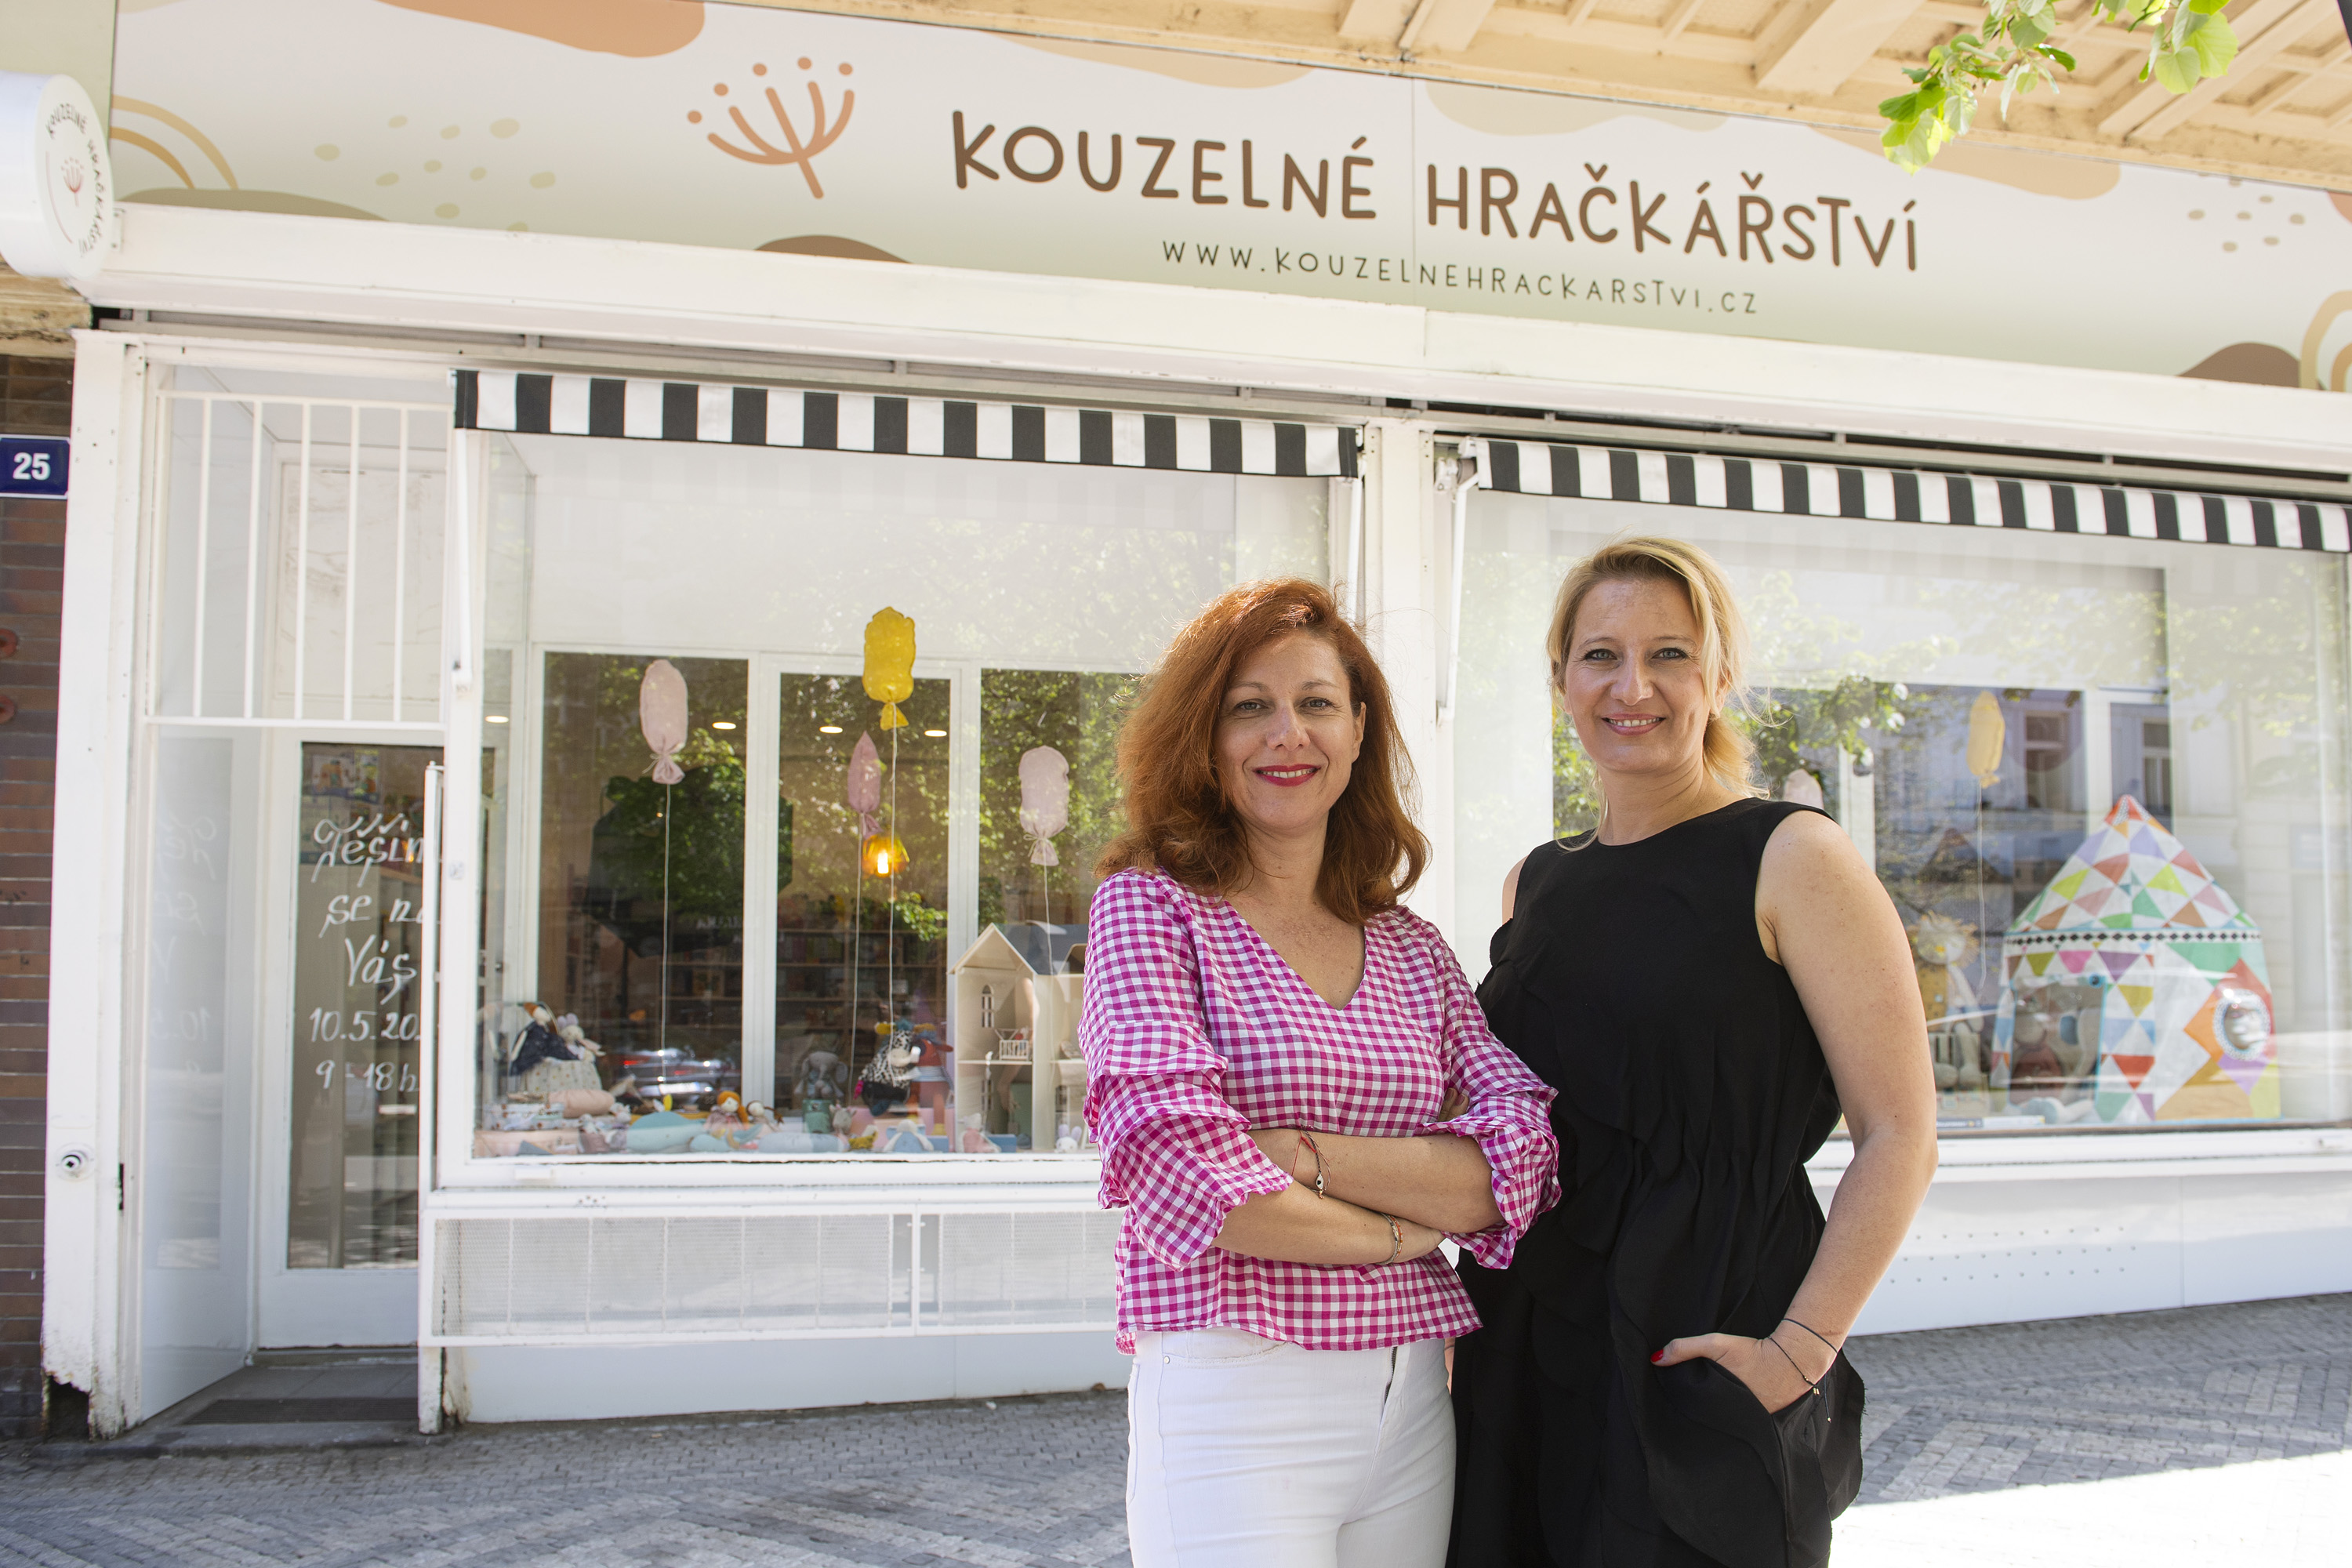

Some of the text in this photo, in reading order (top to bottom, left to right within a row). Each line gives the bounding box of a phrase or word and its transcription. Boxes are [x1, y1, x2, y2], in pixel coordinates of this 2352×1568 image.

[953, 111, 1918, 271] KOUZELNÉ HRAČKÁŘSTVÍ
[1163, 240, 1759, 314] WWW.KOUZELNEHRACKARSTVI.CZ
[13, 452, 51, 481] 25
[320, 895, 372, 938] se
[344, 934, 417, 1006] Vás
